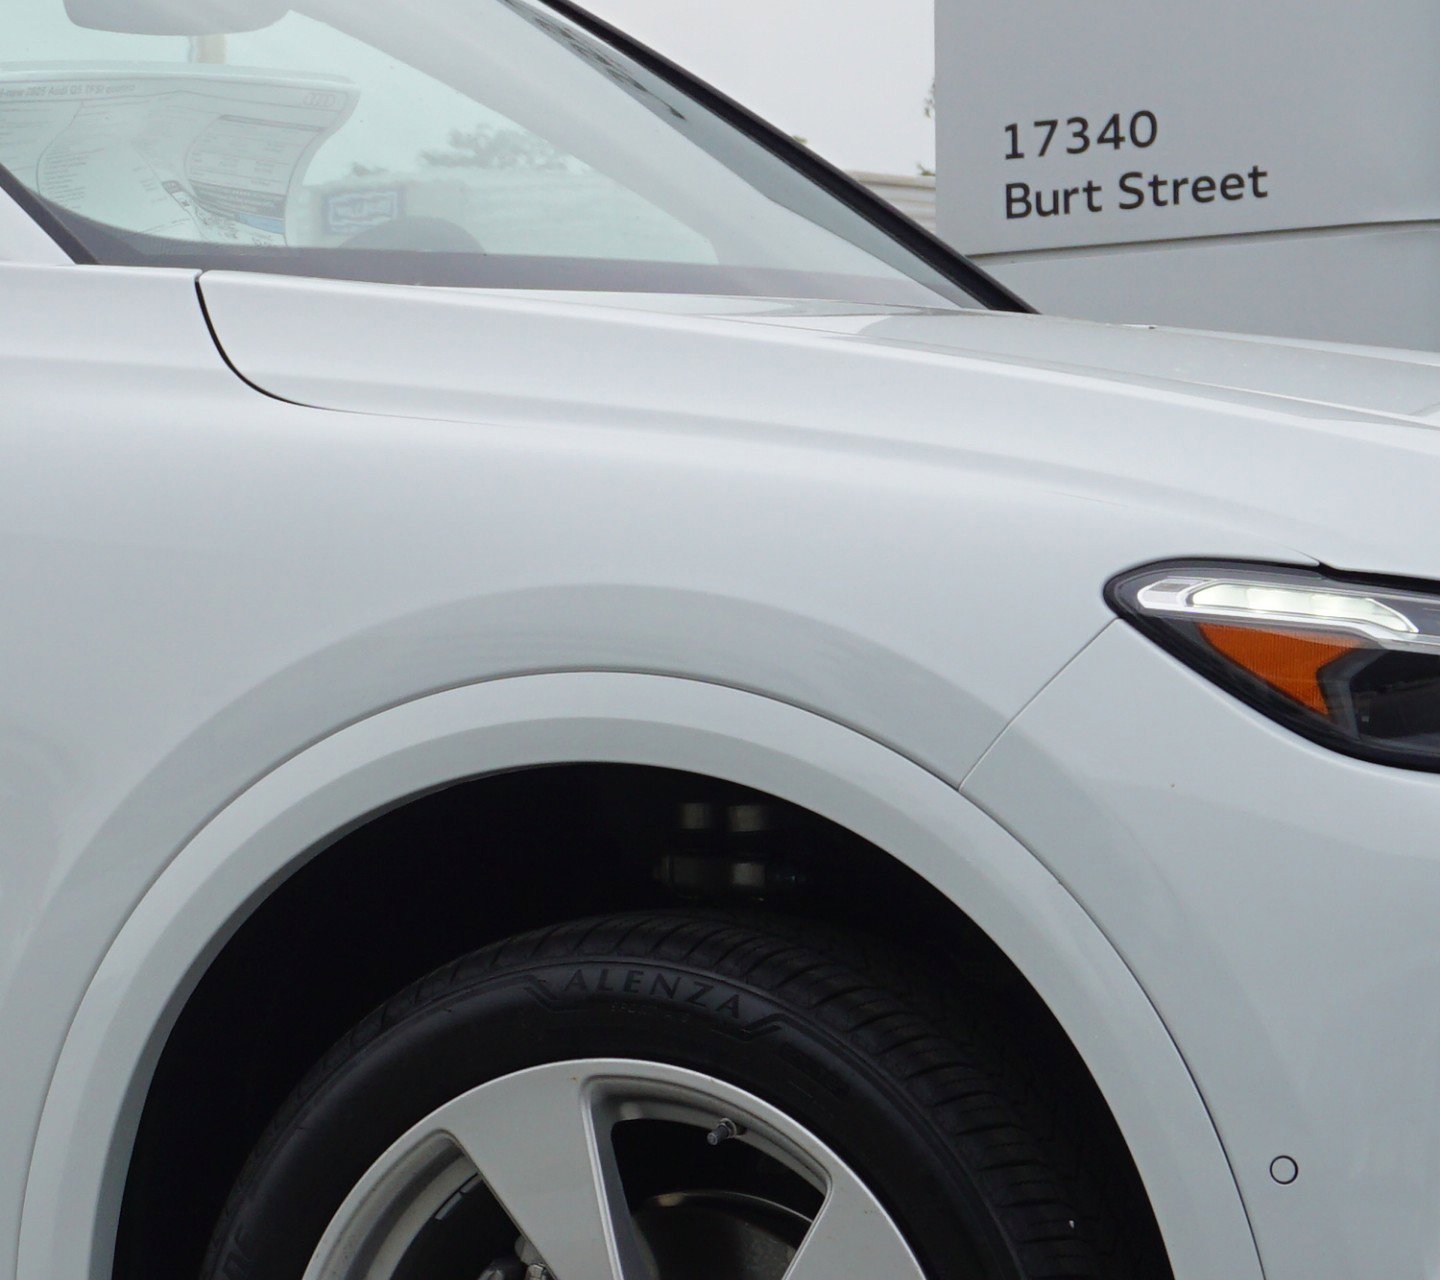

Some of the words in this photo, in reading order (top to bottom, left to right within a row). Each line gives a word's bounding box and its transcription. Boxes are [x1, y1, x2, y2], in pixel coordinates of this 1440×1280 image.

[1004, 110, 1158, 160] 17340
[1005, 179, 1103, 219] Burt
[1118, 165, 1268, 210] Street
[564, 968, 741, 1020] ALENZA
